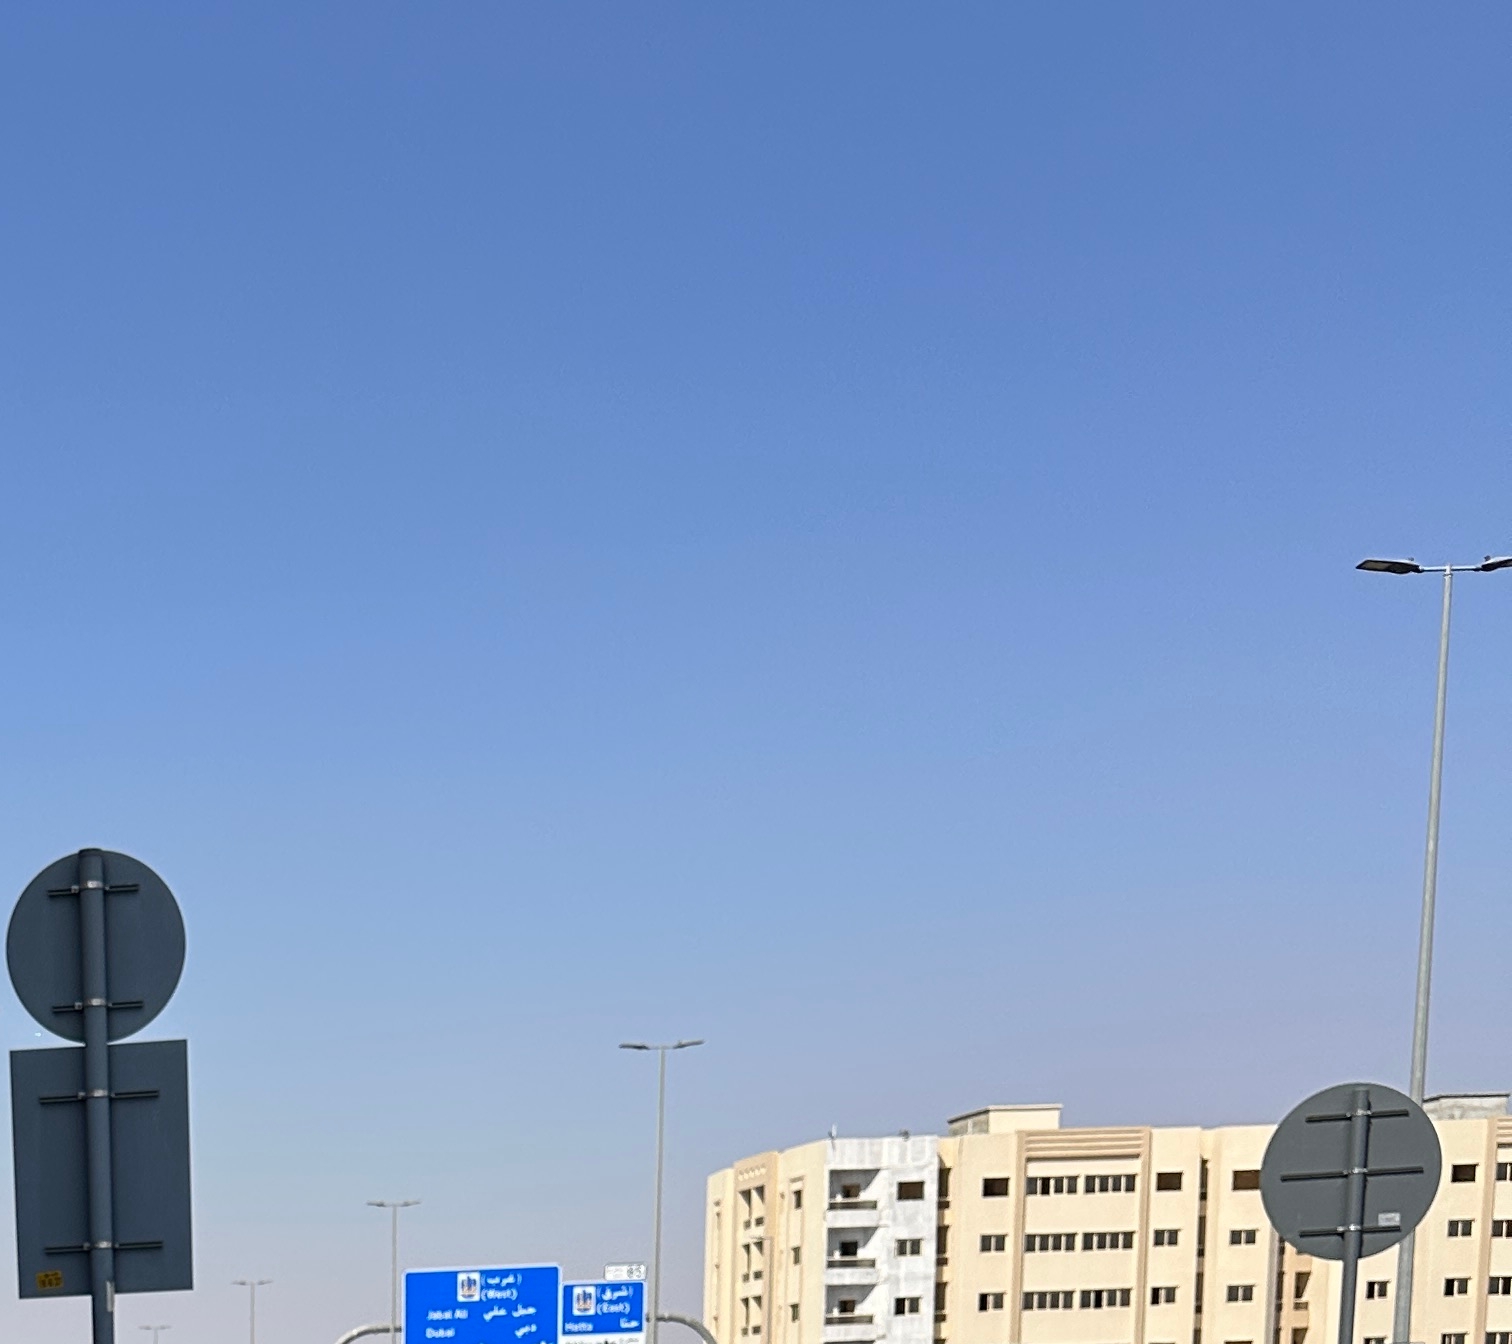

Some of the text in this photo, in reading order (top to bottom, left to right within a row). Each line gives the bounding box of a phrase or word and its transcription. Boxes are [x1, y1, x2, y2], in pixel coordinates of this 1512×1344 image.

[481, 1288, 518, 1302] (West)
[454, 1307, 468, 1319] Ali
[483, 1304, 508, 1322] علي
[596, 1302, 631, 1316] (East)
[425, 1327, 456, 1338] Dubai
[514, 1323, 538, 1338] دبي
